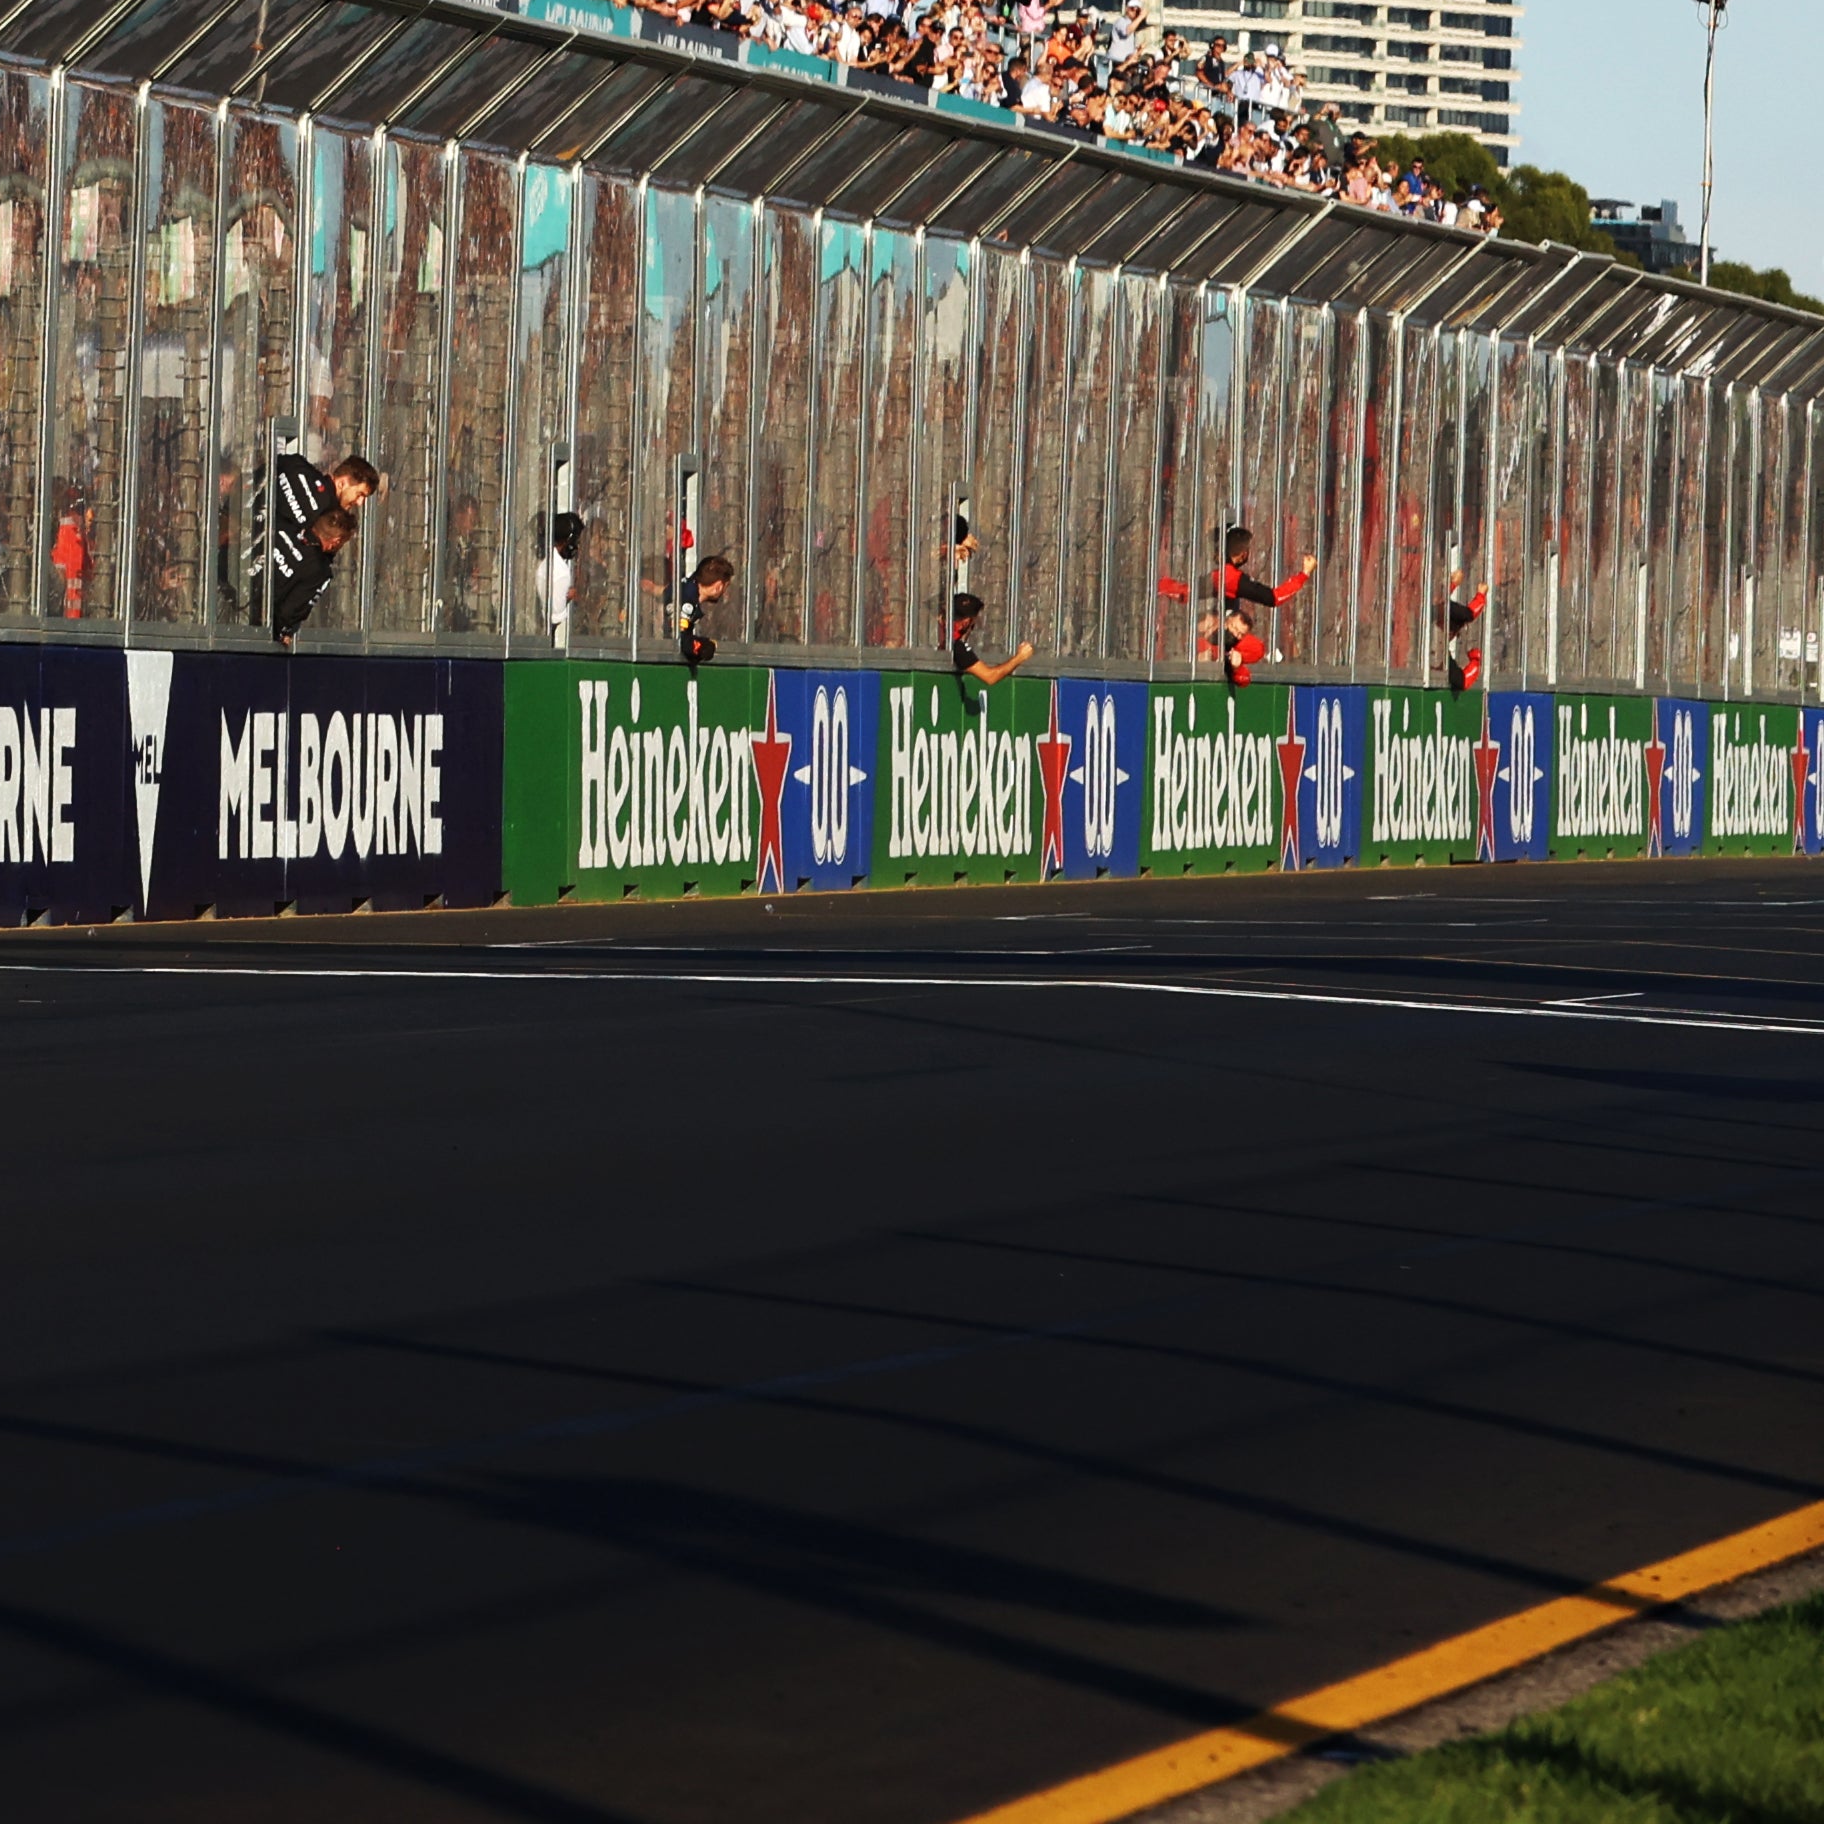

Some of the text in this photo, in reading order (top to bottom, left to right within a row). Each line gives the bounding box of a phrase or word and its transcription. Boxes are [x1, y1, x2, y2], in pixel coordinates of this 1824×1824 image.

[132, 734, 163, 785] MEL
[219, 706, 444, 861] MELBOURNE
[578, 677, 752, 870] Heineken
[888, 685, 1033, 859] Heineken
[1152, 692, 1274, 852] Heineken
[1372, 697, 1472, 842] Heineken
[1557, 702, 1643, 838] Heineken
[1711, 710, 1789, 838] Heineken
